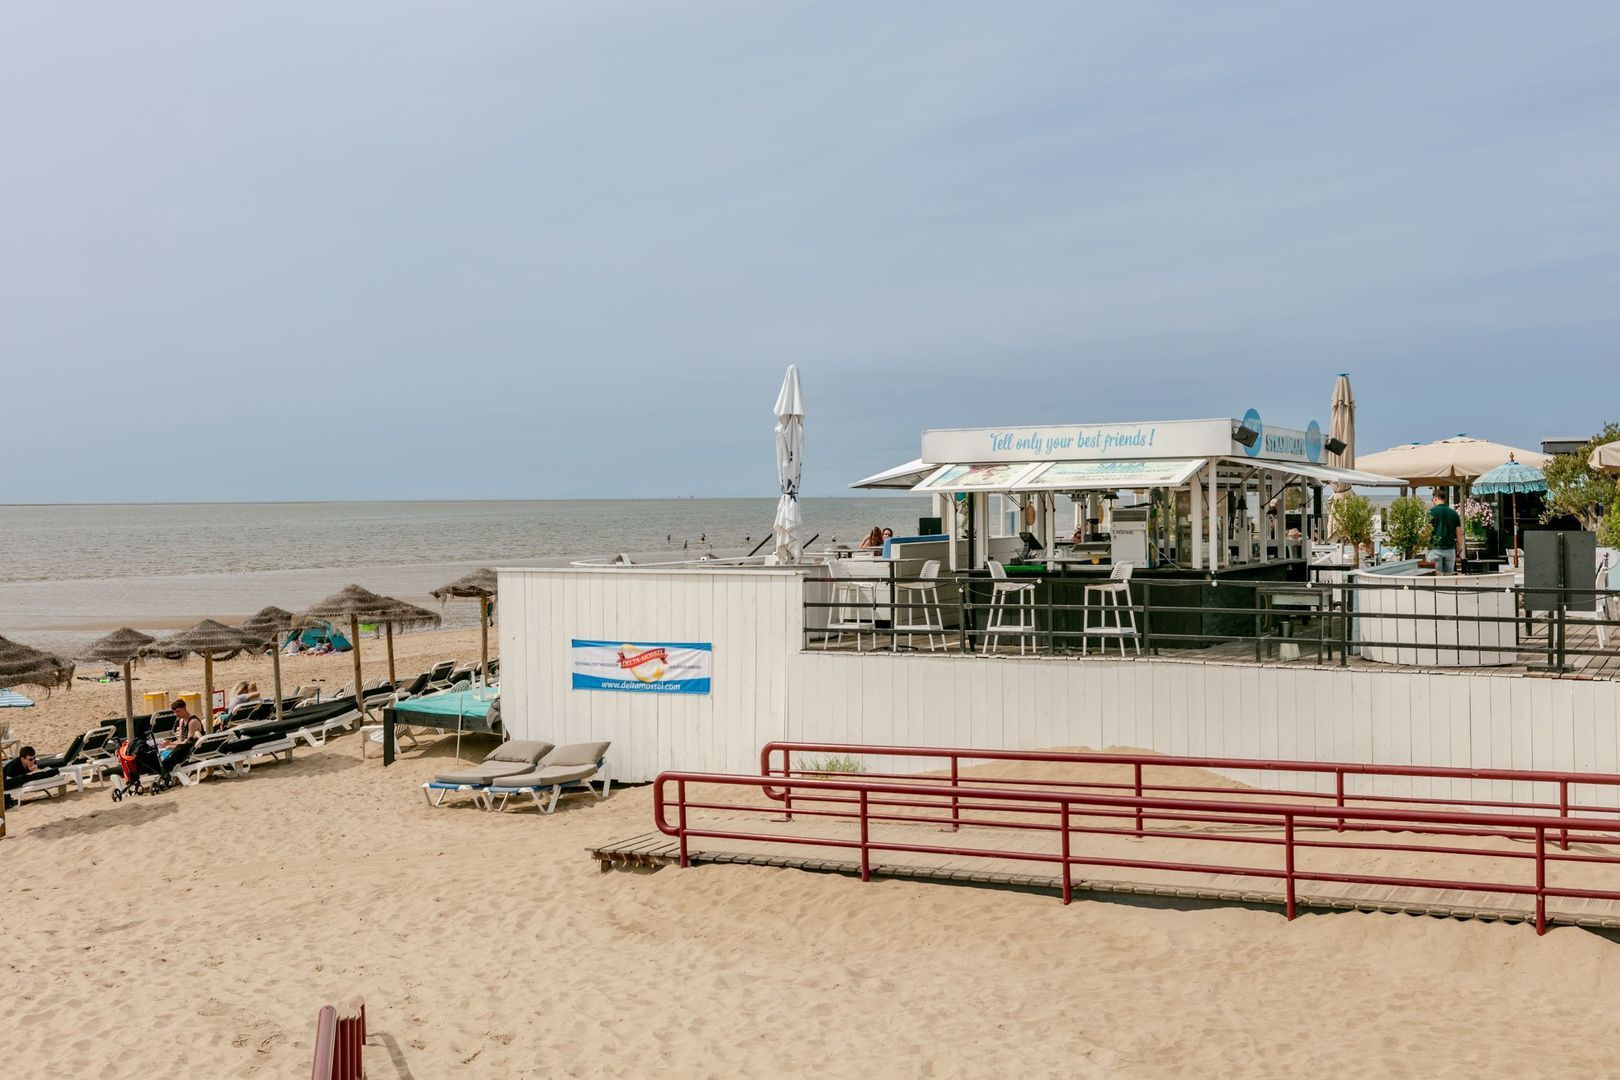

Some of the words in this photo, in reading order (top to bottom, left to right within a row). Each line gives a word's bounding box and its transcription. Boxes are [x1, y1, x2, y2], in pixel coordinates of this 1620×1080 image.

[990, 431, 1014, 452] Tell
[1016, 432, 1043, 455] only
[1045, 437, 1074, 455] your
[1077, 430, 1102, 448] best
